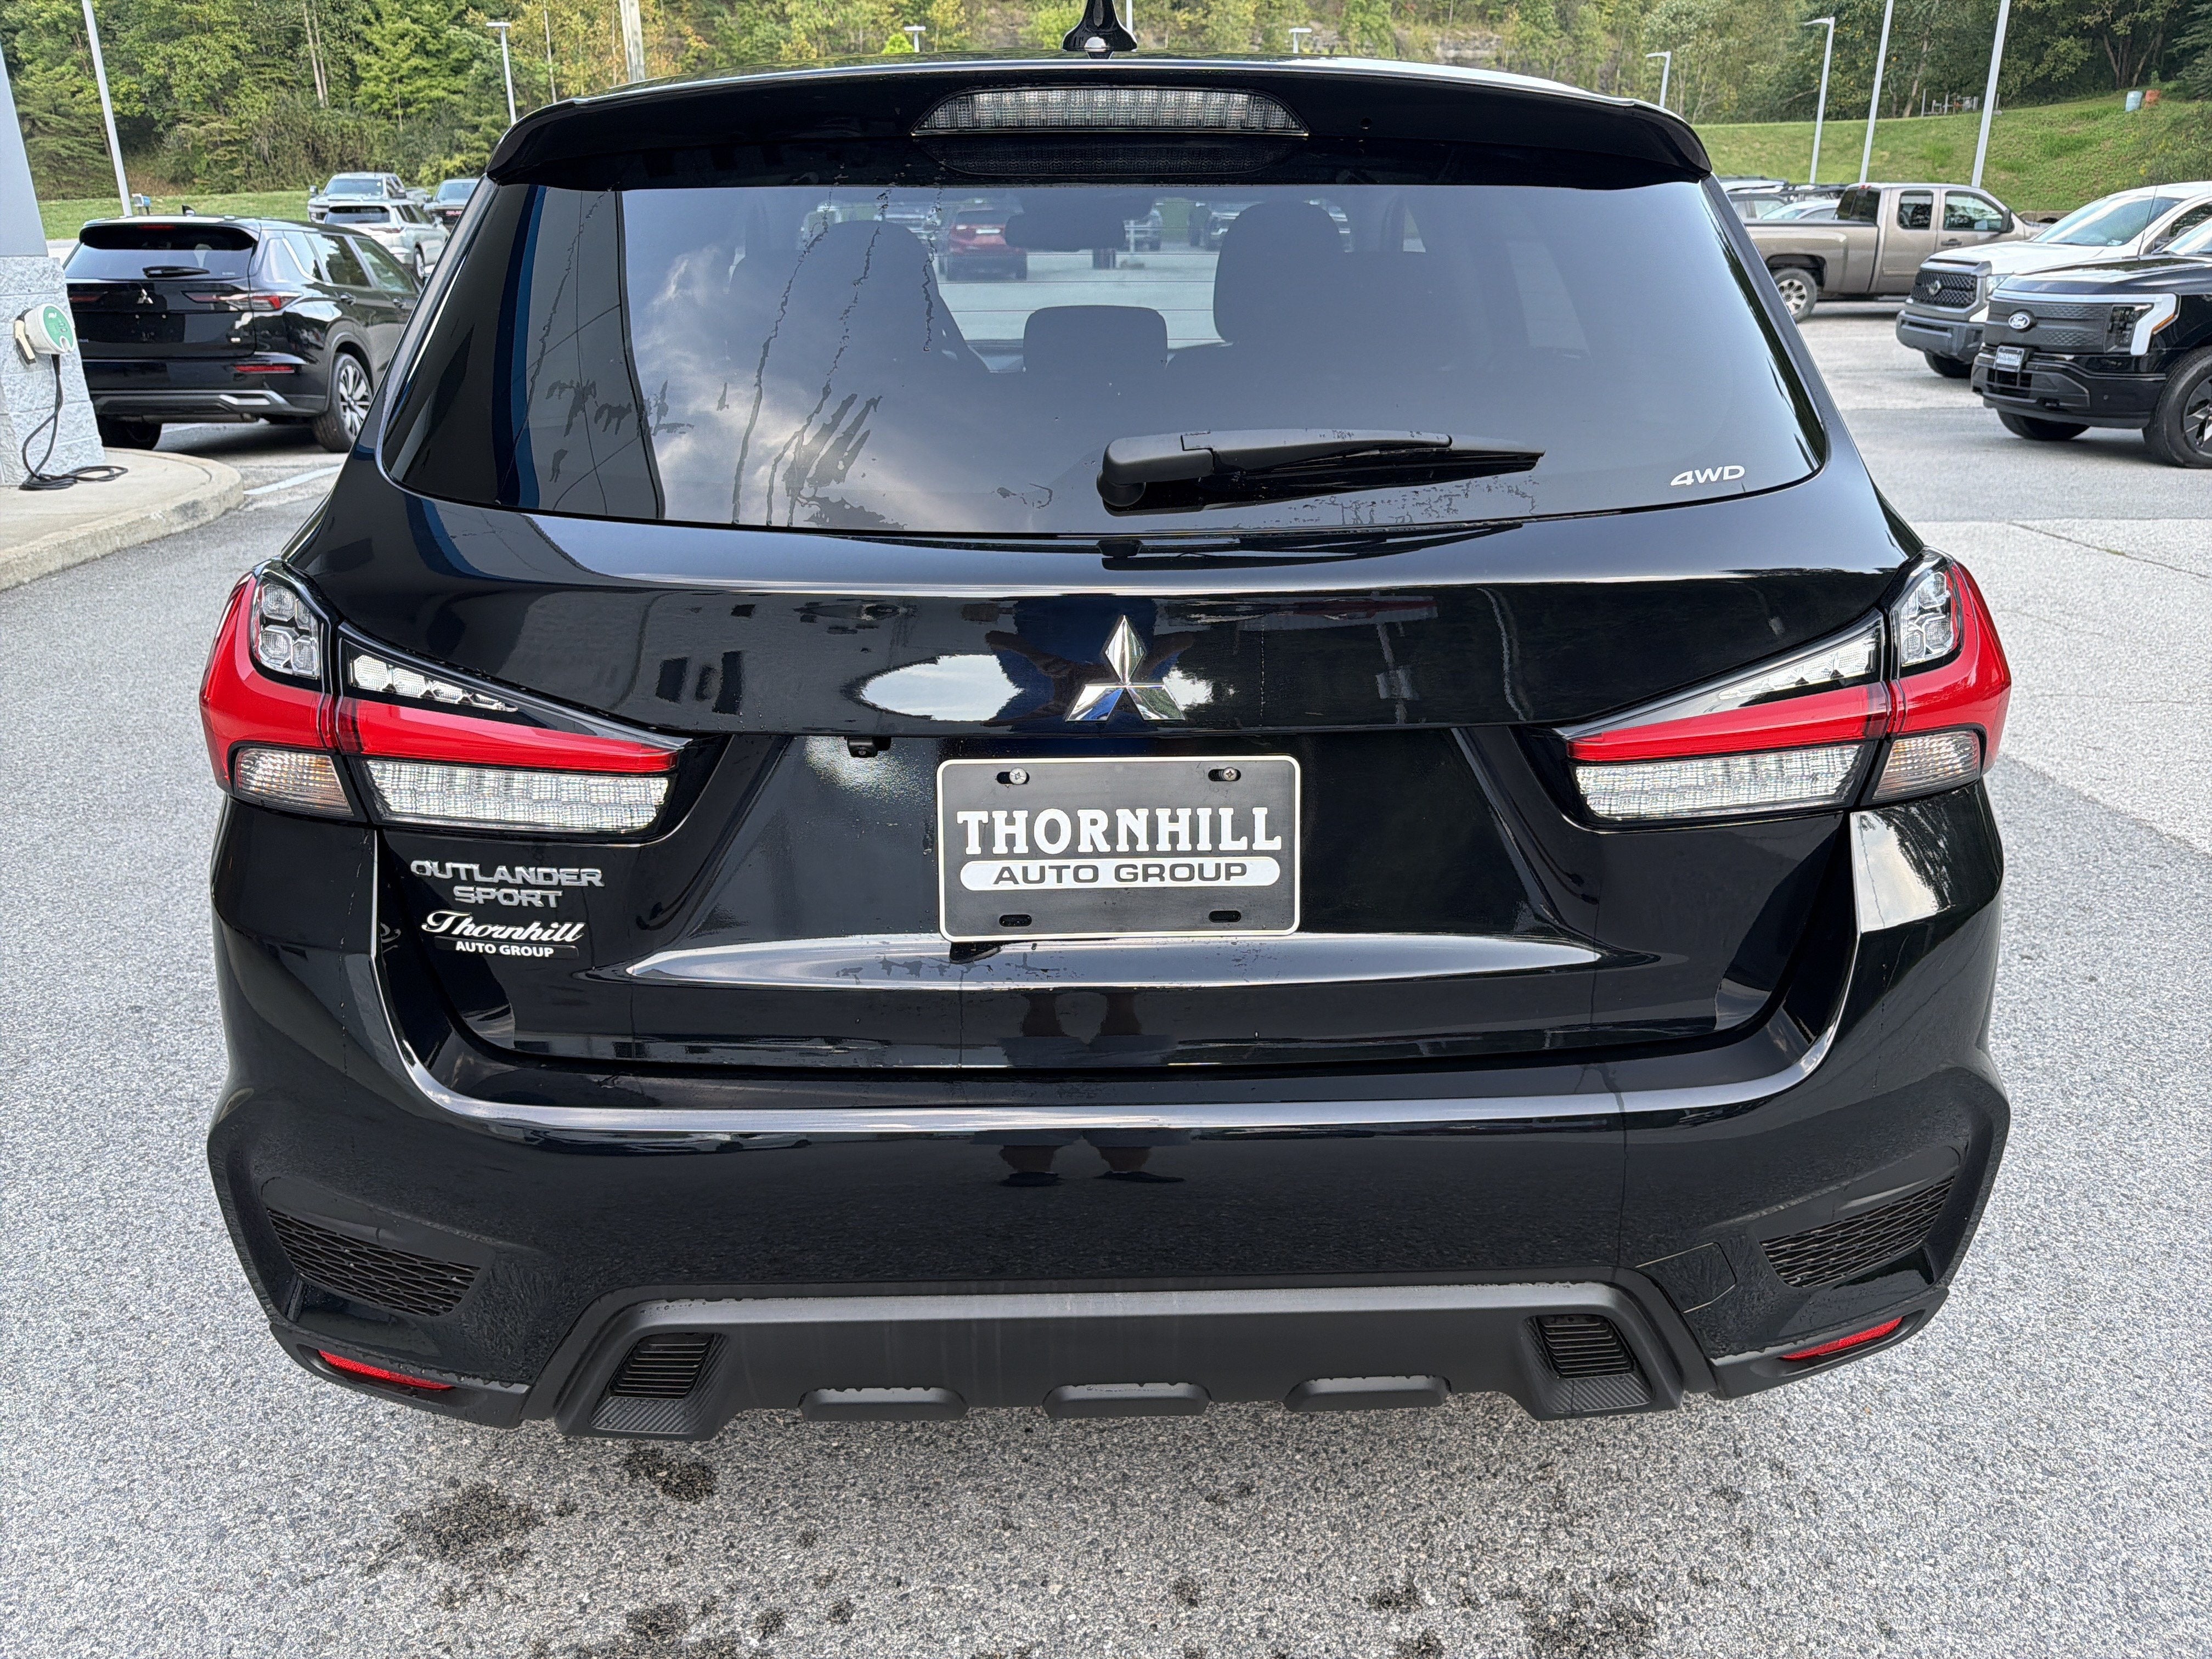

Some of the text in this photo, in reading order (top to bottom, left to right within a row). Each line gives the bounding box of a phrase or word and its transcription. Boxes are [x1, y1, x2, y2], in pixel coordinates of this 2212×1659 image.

[1670, 465, 1745, 486] 4WD
[957, 807, 1282, 855] THORNHILL
[410, 860, 605, 887] OUTLANDER
[993, 863, 1247, 884] AUTO GROUP
[453, 885, 563, 908] SPORT
[421, 910, 585, 942] Thornhill
[455, 940, 554, 957] AUTO GROUP
